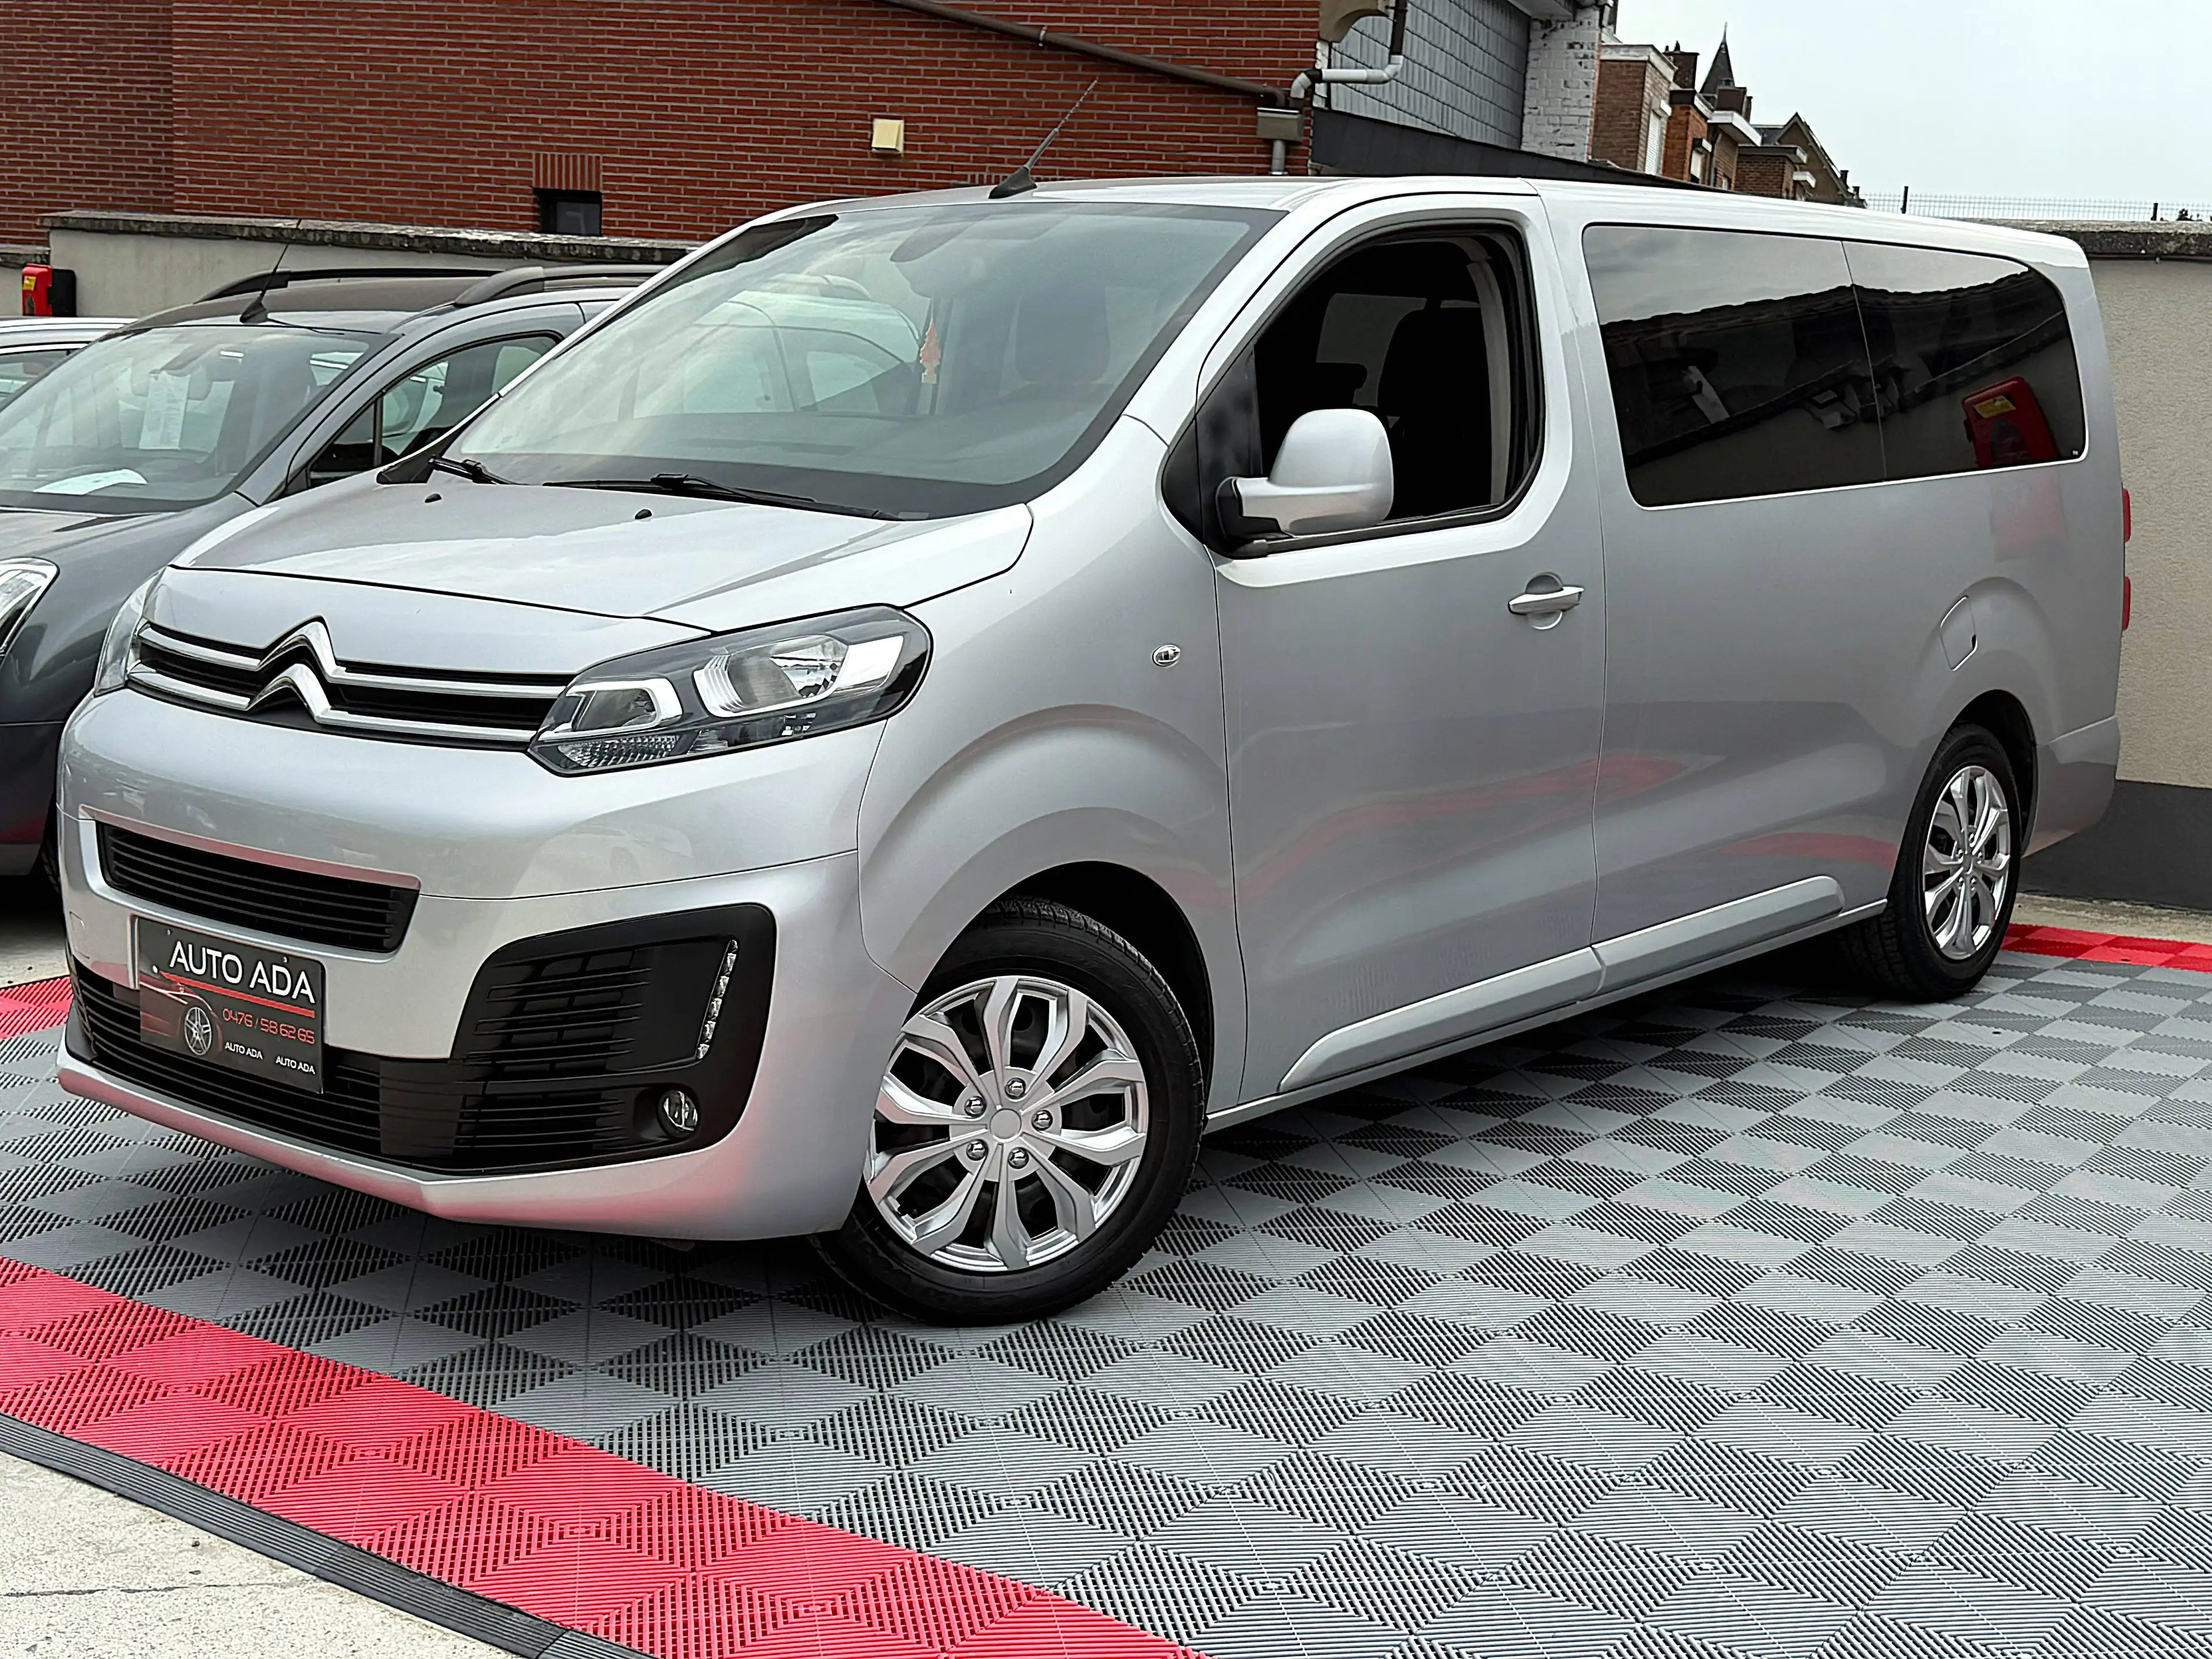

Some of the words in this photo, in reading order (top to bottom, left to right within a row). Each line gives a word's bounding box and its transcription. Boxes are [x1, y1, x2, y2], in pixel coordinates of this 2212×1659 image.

[169, 941, 243, 983] AUTO
[249, 961, 315, 1003] ADA
[222, 1008, 253, 1027] 0476
[260, 1018, 278, 1035] 58
[280, 1024, 296, 1040] 62
[298, 1028, 315, 1044] 65
[225, 1041, 245, 1054] AUTO
[246, 1048, 263, 1059] ADA
[275, 1056, 297, 1069] AUTO
[297, 1062, 316, 1074] ADA
